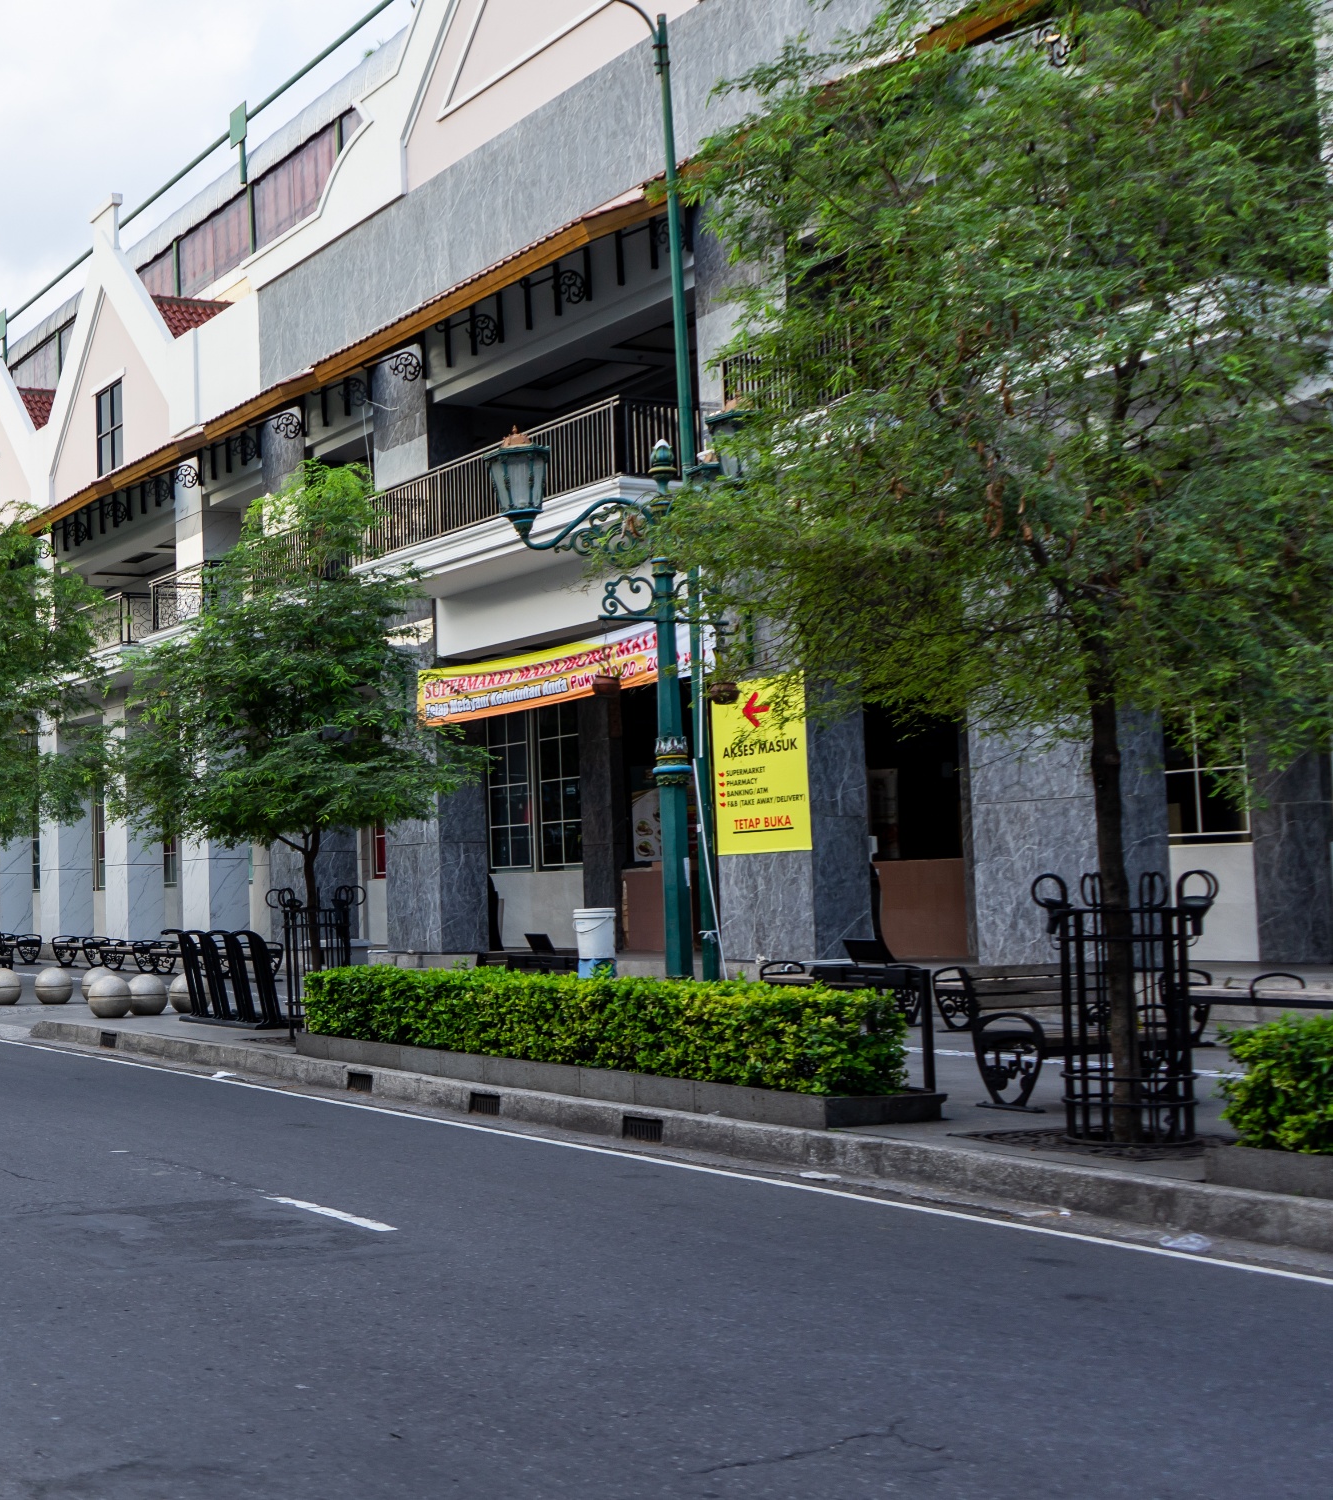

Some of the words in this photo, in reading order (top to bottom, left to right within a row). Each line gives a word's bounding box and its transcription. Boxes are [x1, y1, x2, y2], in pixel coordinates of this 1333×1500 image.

[517, 646, 613, 680] MALIOBORO
[491, 684, 542, 706] Kebutuhan
[542, 677, 569, 697] Anda
[723, 743, 755, 759] AKSES
[758, 738, 798, 754] MASUK
[726, 766, 766, 777] SUPERMARKET
[726, 778, 758, 787] PHARMACY
[734, 818, 761, 830] TETAP
[764, 815, 792, 828] BUKA
